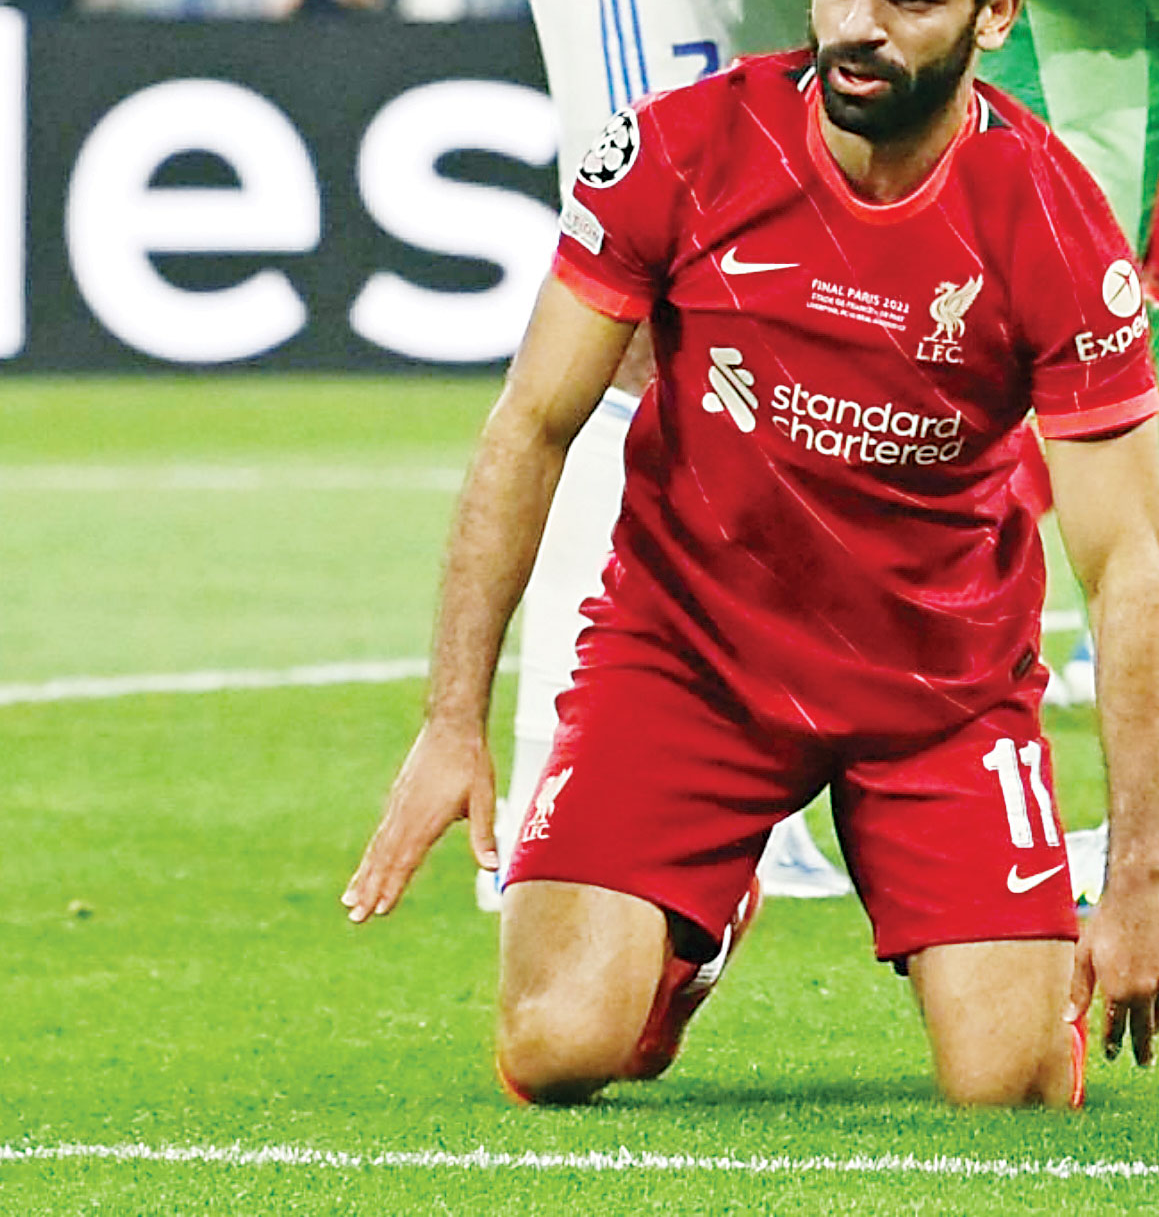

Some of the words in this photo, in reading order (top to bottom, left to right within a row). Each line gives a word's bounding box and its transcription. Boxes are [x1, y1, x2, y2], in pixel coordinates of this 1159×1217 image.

[811, 278, 845, 296] FINAL
[847, 287, 880, 306] PARIS
[771, 383, 961, 439] standard
[771, 415, 966, 465] chartered
[982, 737, 1060, 849] 11
